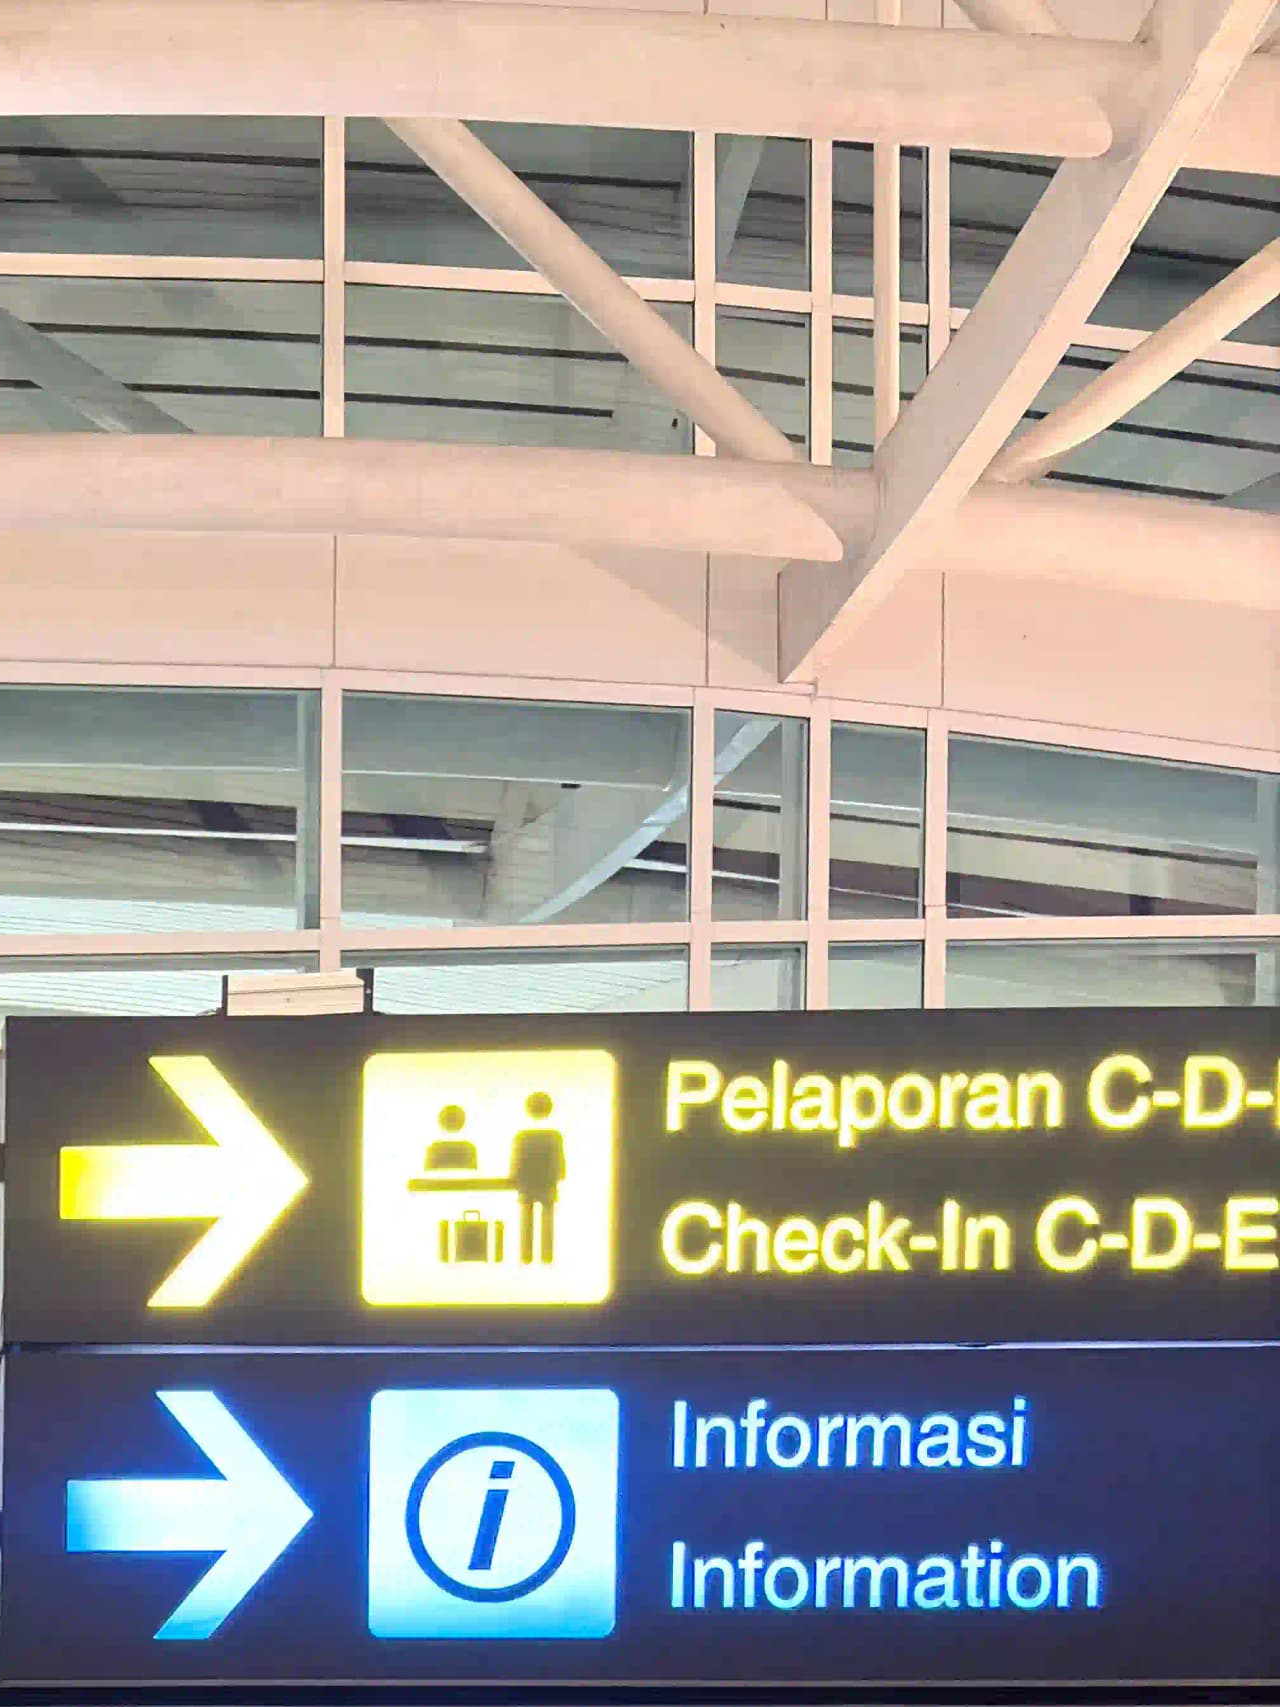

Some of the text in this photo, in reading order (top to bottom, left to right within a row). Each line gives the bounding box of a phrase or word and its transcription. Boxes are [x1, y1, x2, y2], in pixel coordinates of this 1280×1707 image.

[666, 1053, 1280, 1148] Pelaporan C-D-
[661, 1195, 1280, 1275] Check-In C-D-E
[670, 1396, 1029, 1470] Informasi
[670, 1538, 1104, 1612] Information
